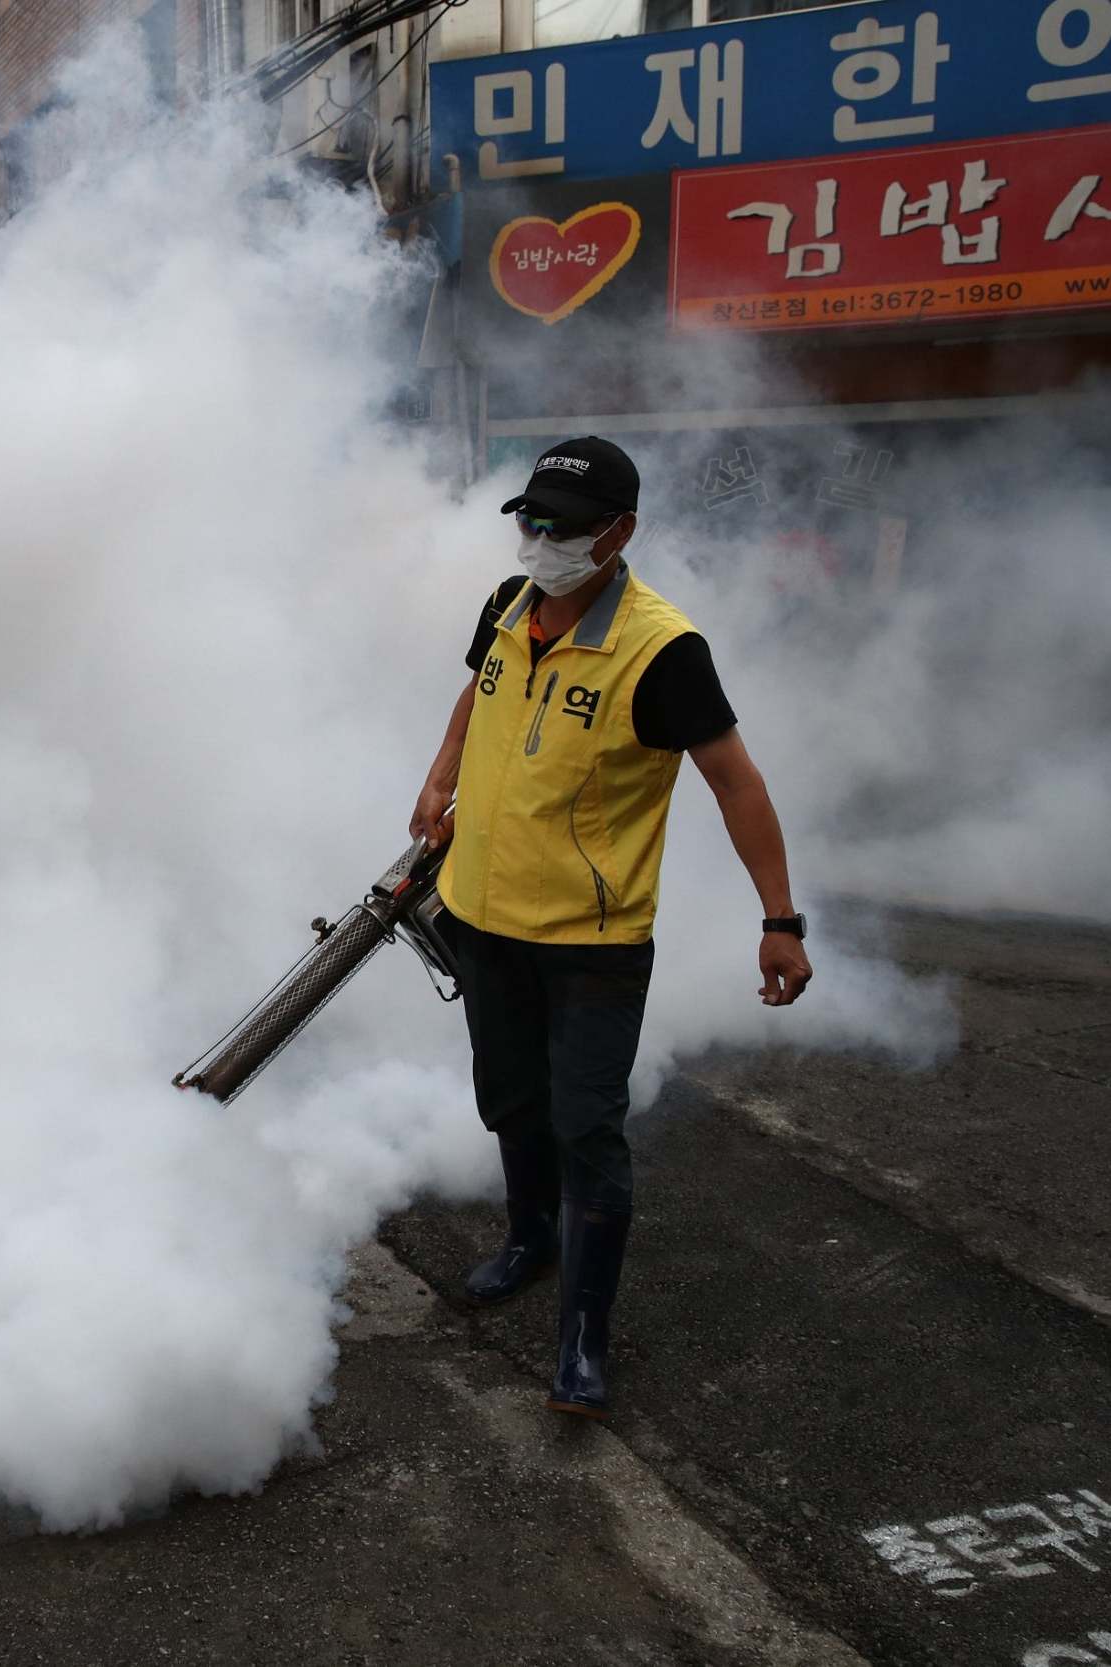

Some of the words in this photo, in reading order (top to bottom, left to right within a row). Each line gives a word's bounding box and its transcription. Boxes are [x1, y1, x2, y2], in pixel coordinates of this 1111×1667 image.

[511, 243, 599, 272] 김밥사랑
[712, 297, 807, 322] 창신본점
[822, 281, 1023, 315] tel:3672-1980
